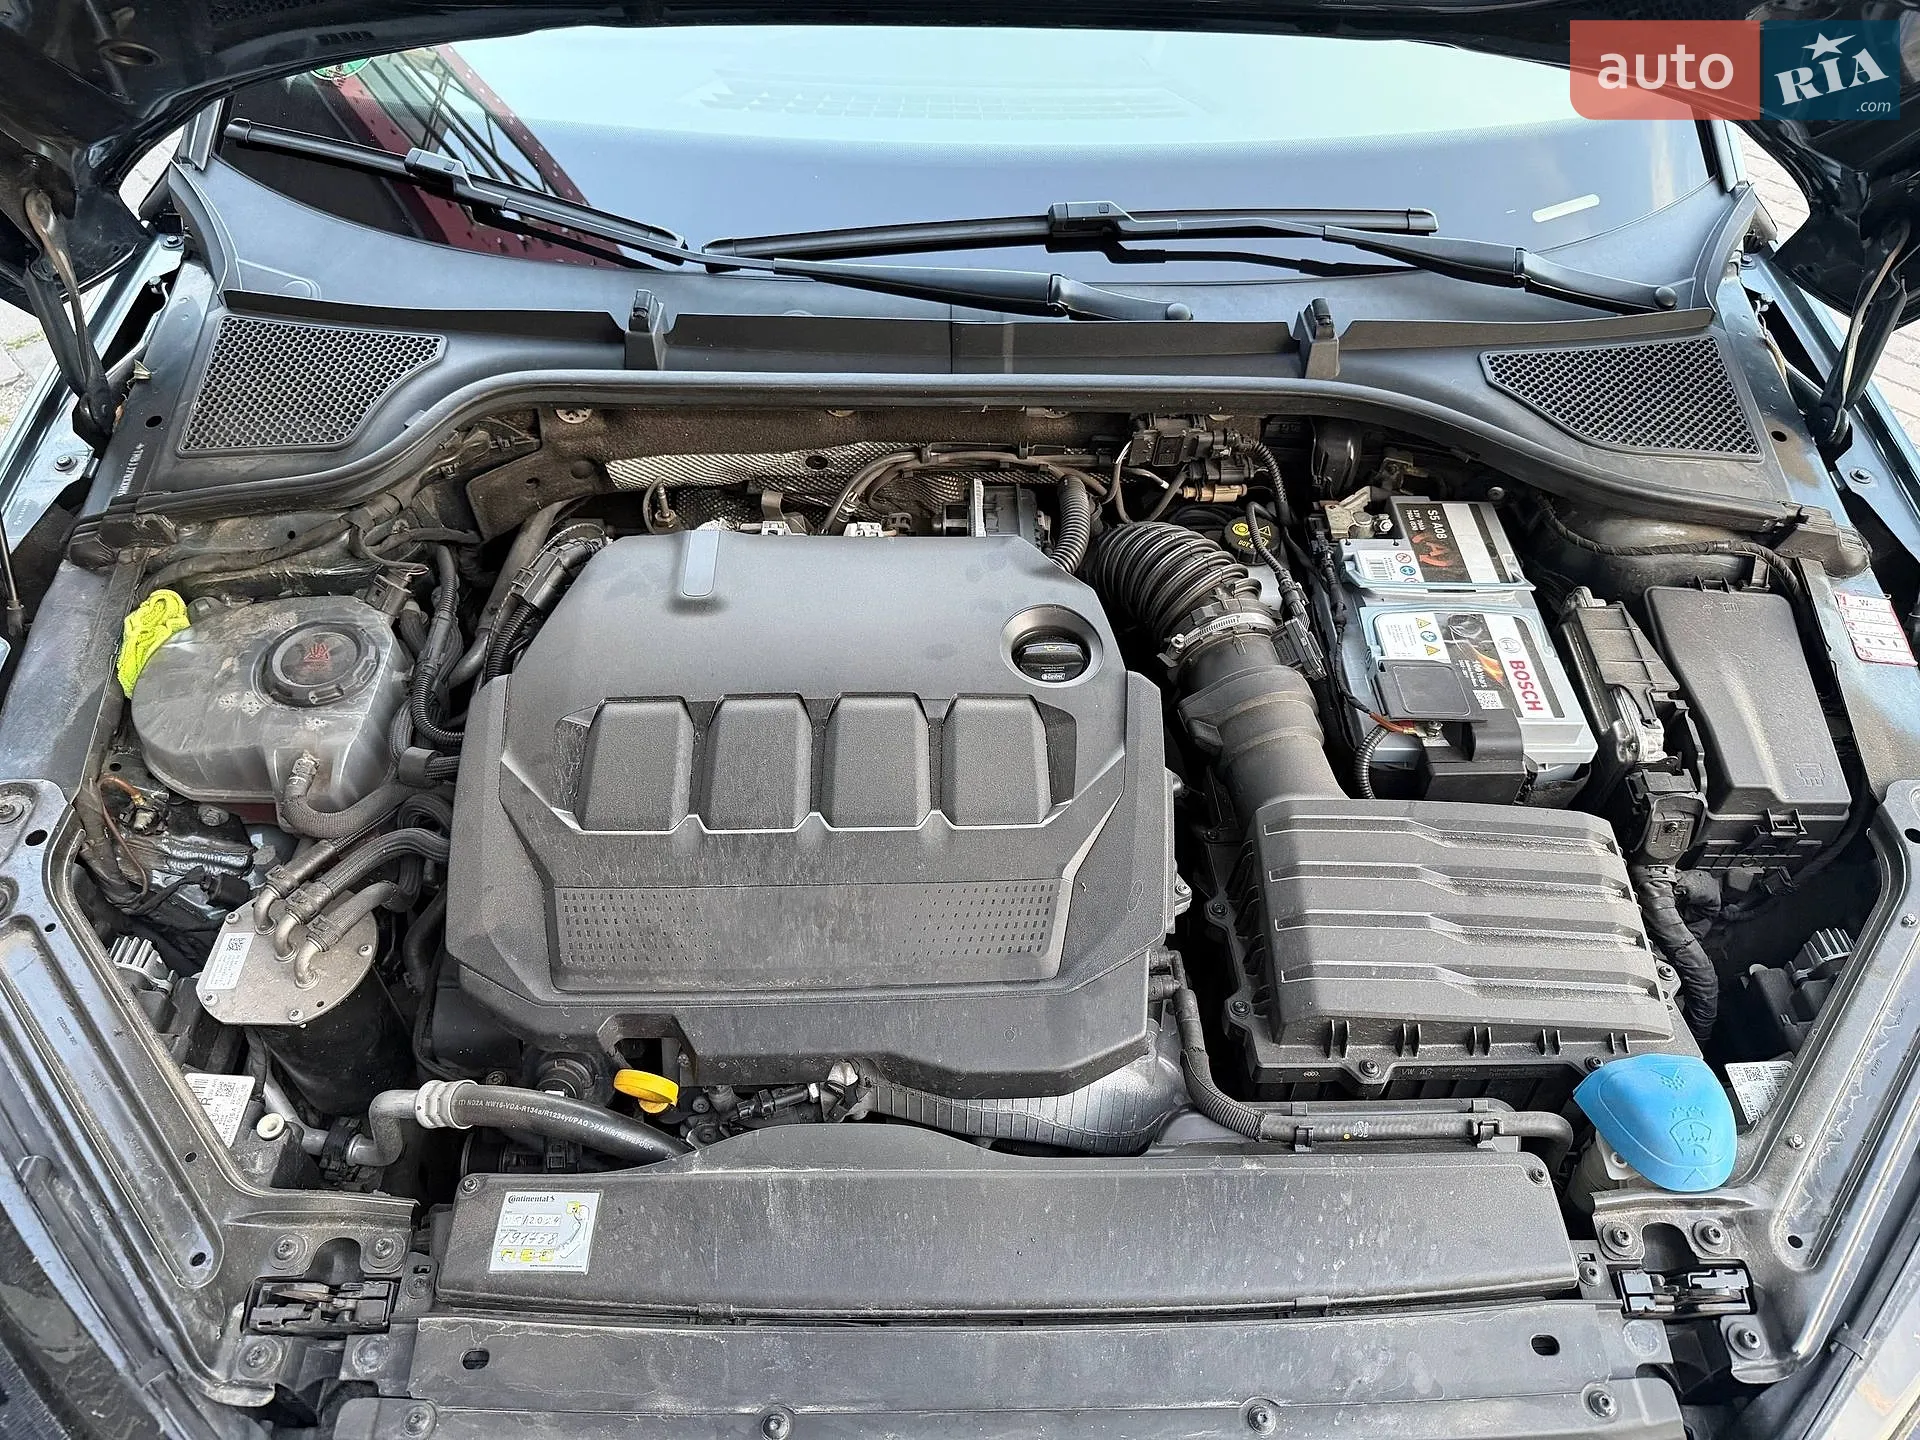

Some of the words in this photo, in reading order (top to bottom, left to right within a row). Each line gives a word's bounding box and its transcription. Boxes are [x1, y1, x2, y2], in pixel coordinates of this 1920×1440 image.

[1427, 510, 1440, 520] S5
[1509, 660, 1543, 710] BOSCH
[508, 1195, 549, 1204] Continental
